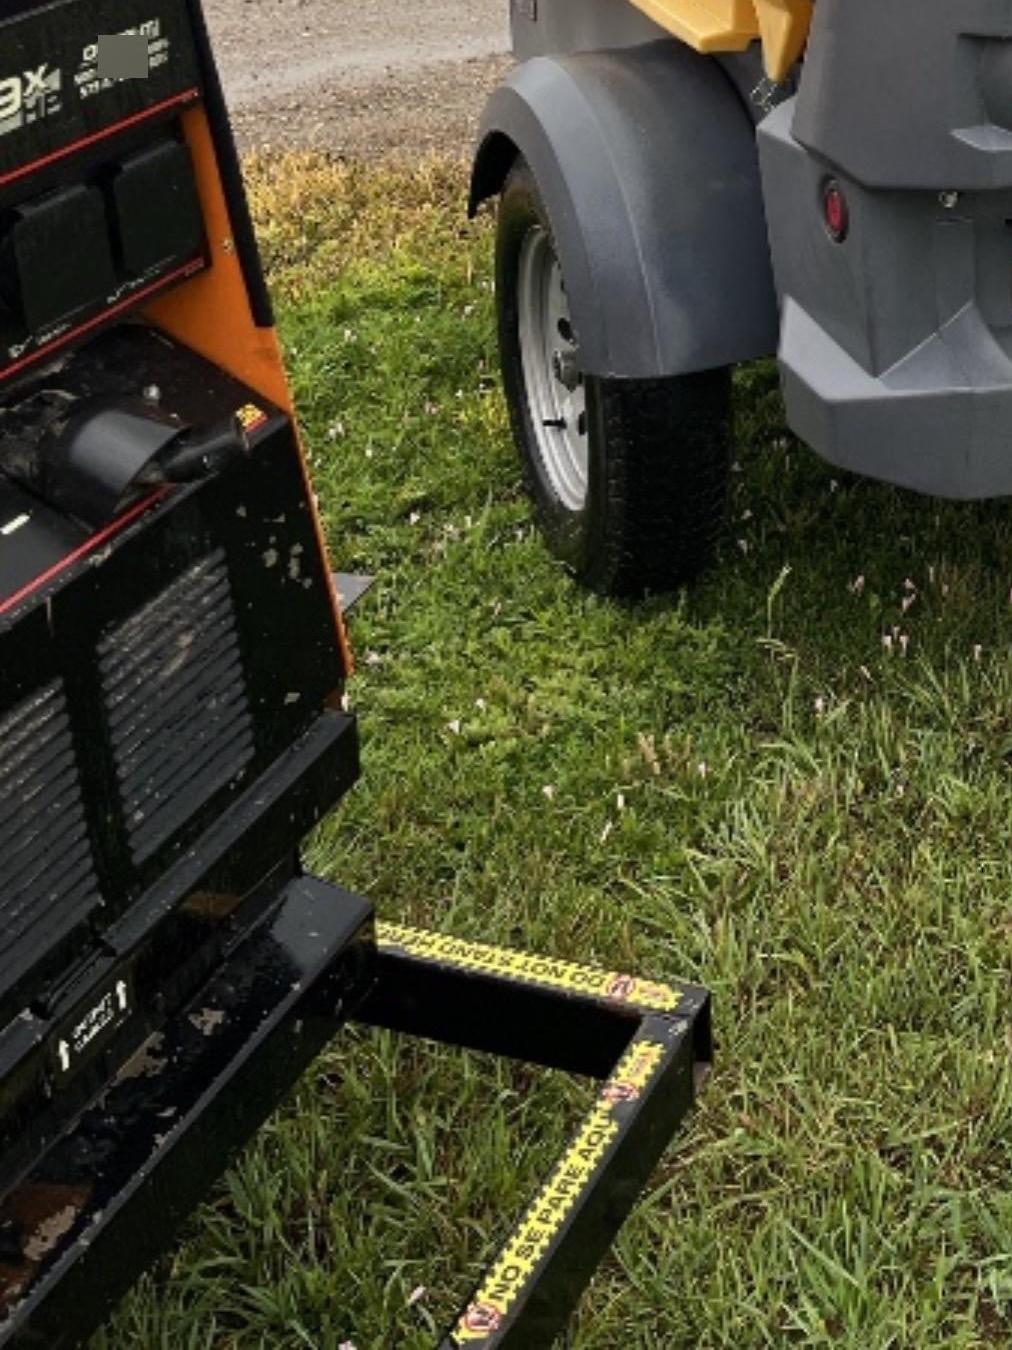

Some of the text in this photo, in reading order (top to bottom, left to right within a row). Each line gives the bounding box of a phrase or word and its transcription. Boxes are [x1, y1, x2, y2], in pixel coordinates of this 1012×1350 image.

[438, 940, 512, 967] STAND
[516, 958, 562, 979] NOT
[569, 968, 608, 987] DO
[489, 1264, 520, 1300] NO
[514, 1227, 545, 1261] SE
[538, 1163, 586, 1223] PARE
